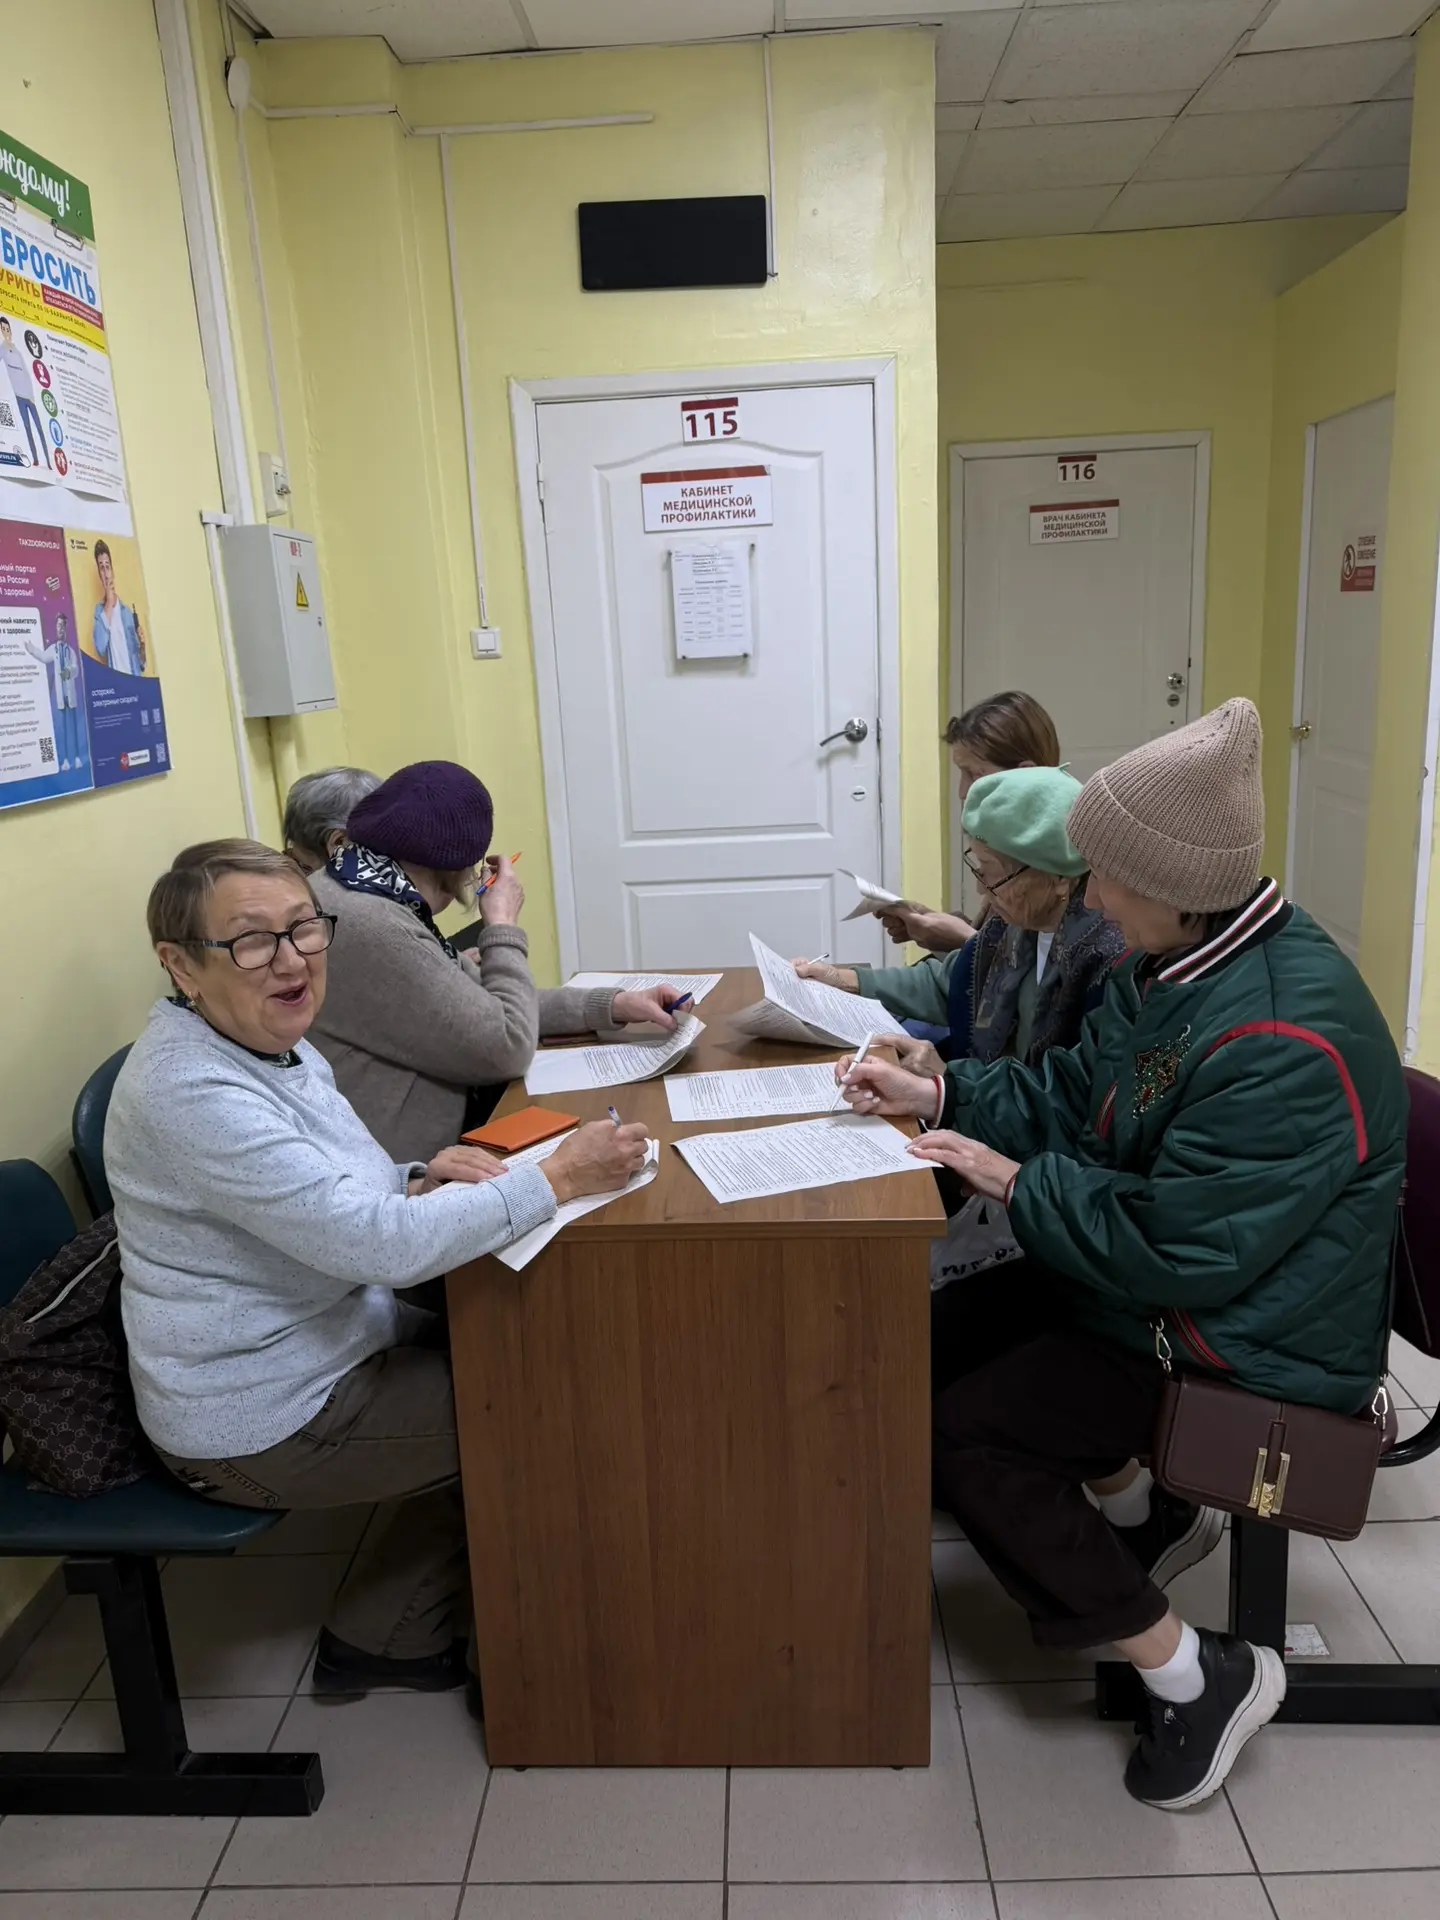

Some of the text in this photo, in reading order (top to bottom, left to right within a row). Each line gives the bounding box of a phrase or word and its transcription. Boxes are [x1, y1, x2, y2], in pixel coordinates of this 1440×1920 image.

[0, 226, 96, 306] БРОСИТЬ
[686, 410, 738, 438] 115
[1060, 463, 1096, 481] 116
[681, 485, 733, 497] КАБИНЕТ
[663, 494, 753, 512] МЕДИЦИНСКОЙ
[661, 508, 756, 523] ПРОФИЛАКТИКИ
[1043, 512, 1106, 523] ВРАЧ КАБИНЕТА
[1044, 519, 1106, 531] МЕДИЦИНСКОЙ
[1041, 527, 1108, 540] ПРОФИЛАКТИКИ
[15, 565, 37, 575] портал
[7, 575, 30, 585] России
[4, 588, 34, 598] здоровье!
